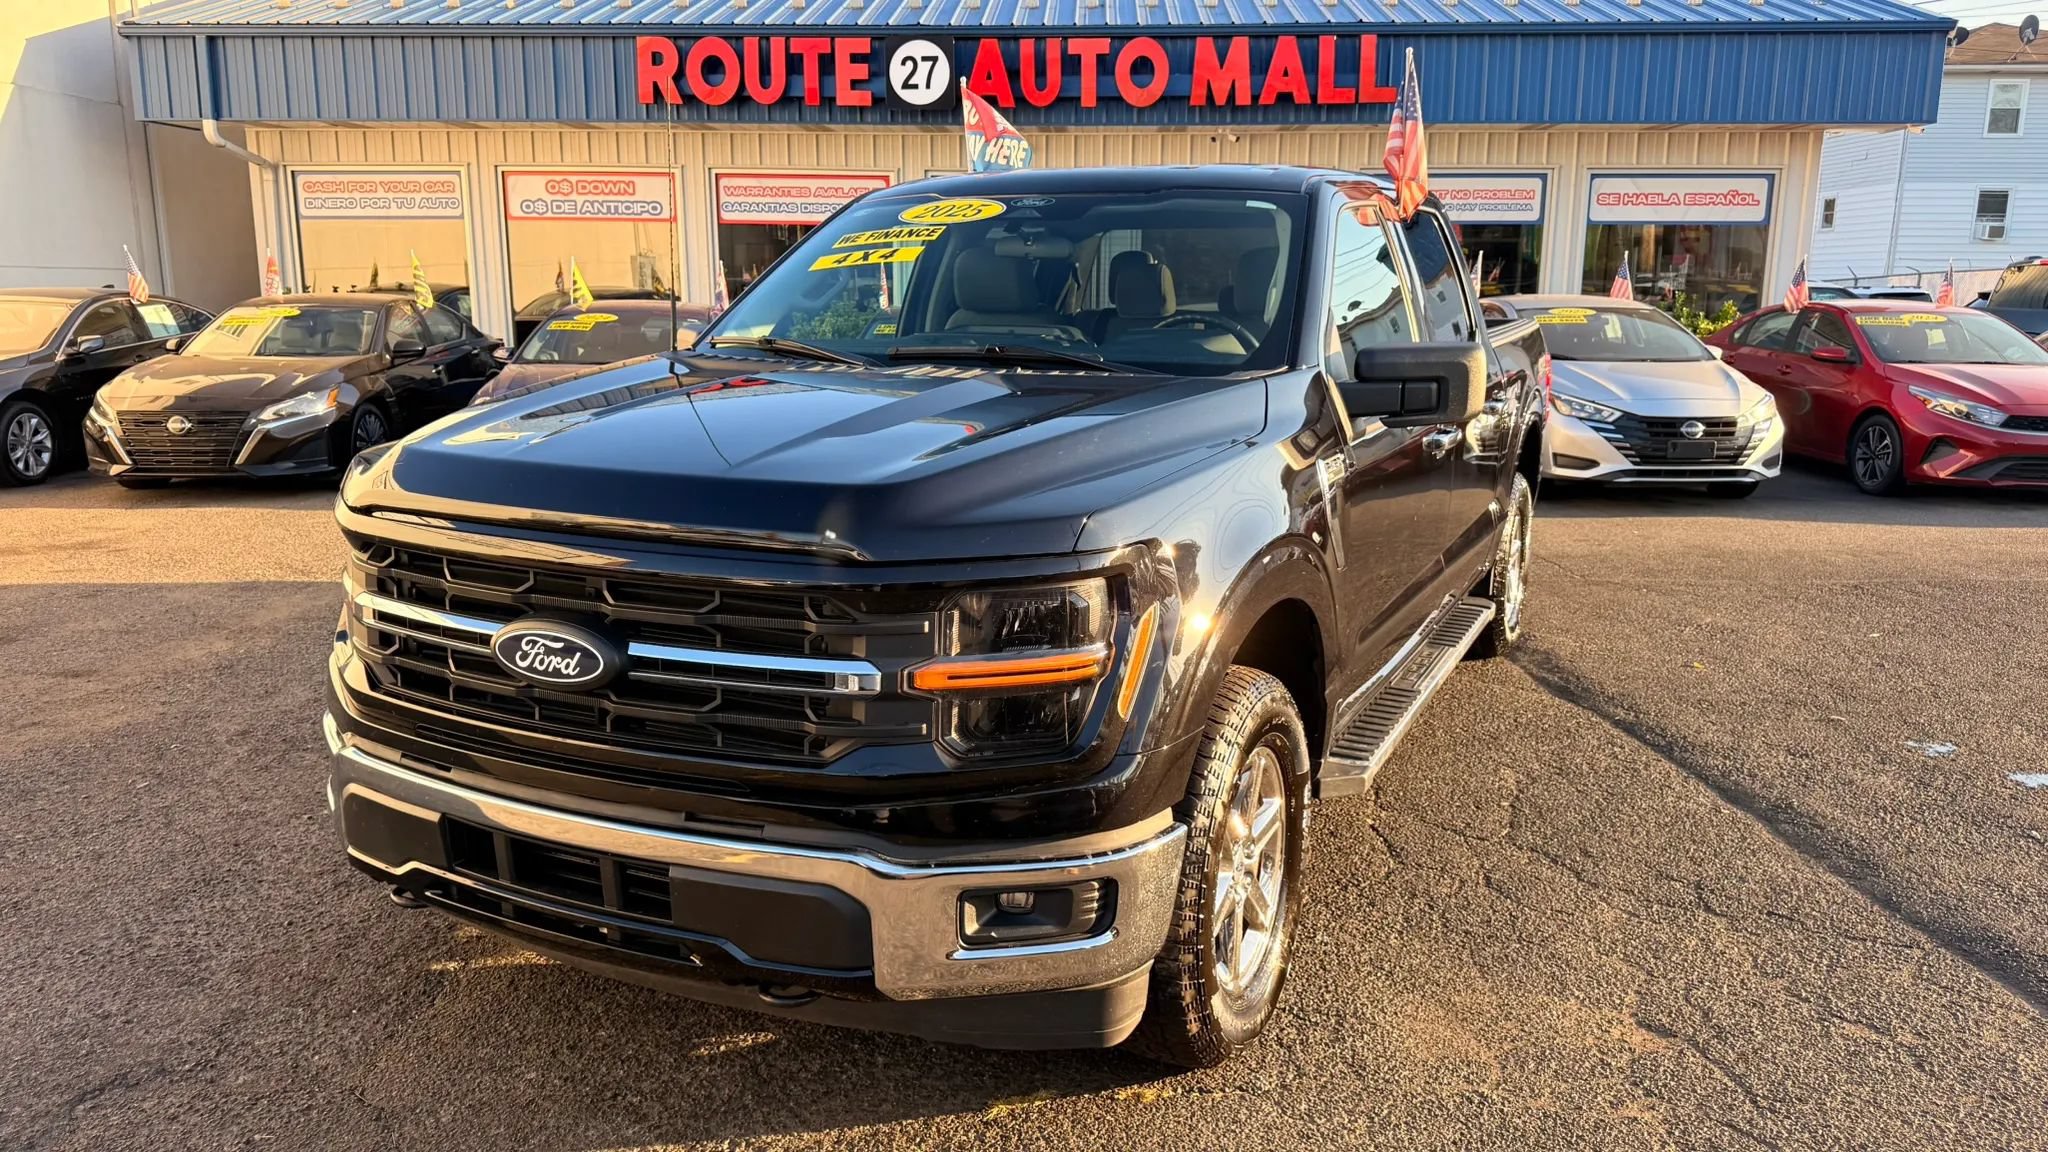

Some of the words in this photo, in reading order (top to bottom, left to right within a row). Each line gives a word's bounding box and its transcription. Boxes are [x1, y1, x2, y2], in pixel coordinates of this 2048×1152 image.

[636, 36, 873, 107] ROUTE
[900, 55, 940, 90] 27
[967, 36, 1170, 109] AUTO
[1190, 34, 1398, 107] MALL
[984, 137, 1029, 168] HERE
[303, 181, 345, 193] CASH
[347, 181, 378, 193] FOR
[379, 182, 421, 193] YOUR
[423, 182, 455, 193] CAR
[576, 181, 636, 196] DOWN
[723, 185, 811, 198] WARRANTIES
[1450, 189, 1470, 200] NO
[1472, 189, 1536, 200] PROBLEM
[304, 197, 357, 209] DINERO
[359, 198, 391, 209] POR
[394, 198, 416, 209] TU
[418, 198, 460, 209] AUTO
[1597, 192, 1621, 206] SE
[1622, 192, 1681, 206] HABLA
[1683, 189, 1761, 207] ESPAÑOL
[551, 200, 577, 215] DE
[579, 200, 664, 216] ANTICIPO
[722, 202, 799, 213] GARANTIAS
[912, 203, 993, 219] 2025
[1455, 203, 1478, 212] HAY
[1479, 203, 1534, 212] PROBLEMA
[838, 233, 865, 246] WE
[865, 227, 942, 242] FINANCE
[515, 636, 581, 676] Ford
